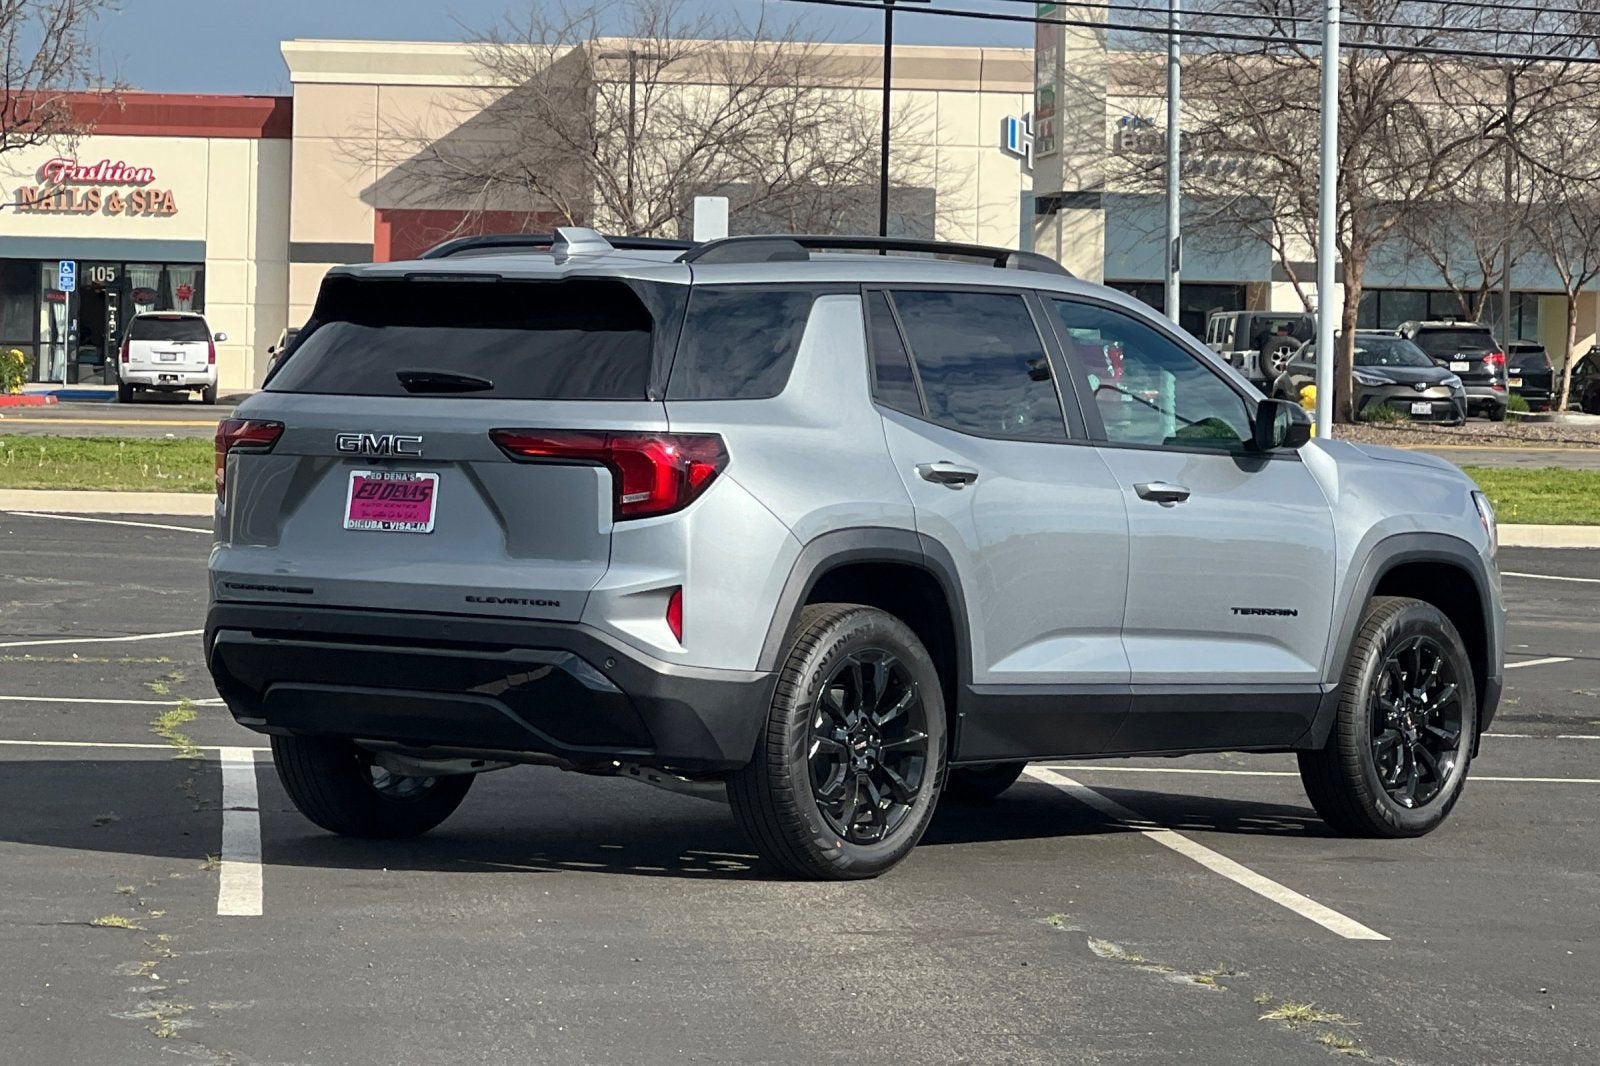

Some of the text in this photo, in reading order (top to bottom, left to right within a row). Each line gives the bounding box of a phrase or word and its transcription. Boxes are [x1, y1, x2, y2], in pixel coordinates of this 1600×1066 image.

[43, 158, 156, 185] Fashion
[18, 186, 178, 214] NAILS & SPA
[89, 266, 115, 282] 105
[336, 433, 422, 456] GMC
[370, 472, 416, 482] ED DENA'S
[465, 596, 560, 607] ELEVATION
[1231, 607, 1298, 616] TERRAIN
